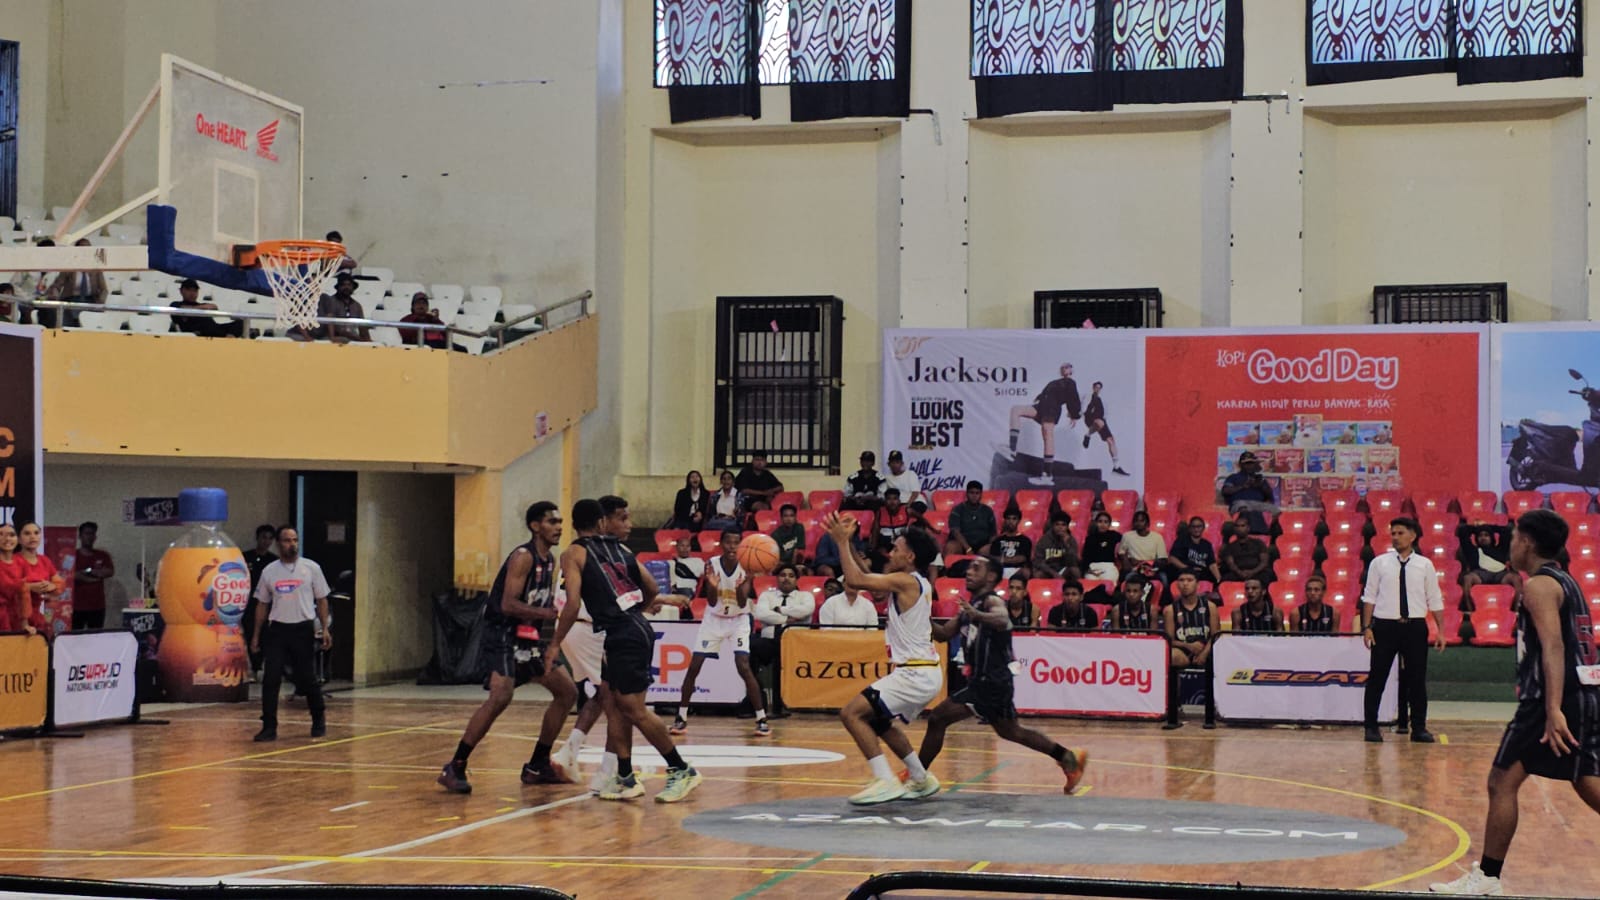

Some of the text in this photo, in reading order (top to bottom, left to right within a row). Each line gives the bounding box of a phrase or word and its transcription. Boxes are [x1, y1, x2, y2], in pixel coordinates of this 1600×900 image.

[196, 112, 215, 138] One
[908, 356, 1028, 383] Jackson
[994, 387, 1028, 397] SHOES
[911, 400, 964, 420] LOOKS
[1217, 399, 1390, 409] KARENA HIDUP PERLU BANYAK RASA
[911, 422, 963, 447] BEST
[909, 457, 943, 477] WALK
[918, 475, 967, 491] ACKSON
[737, 637, 743, 647] 5
[730, 812, 1358, 840] AZAWEAR.COM
